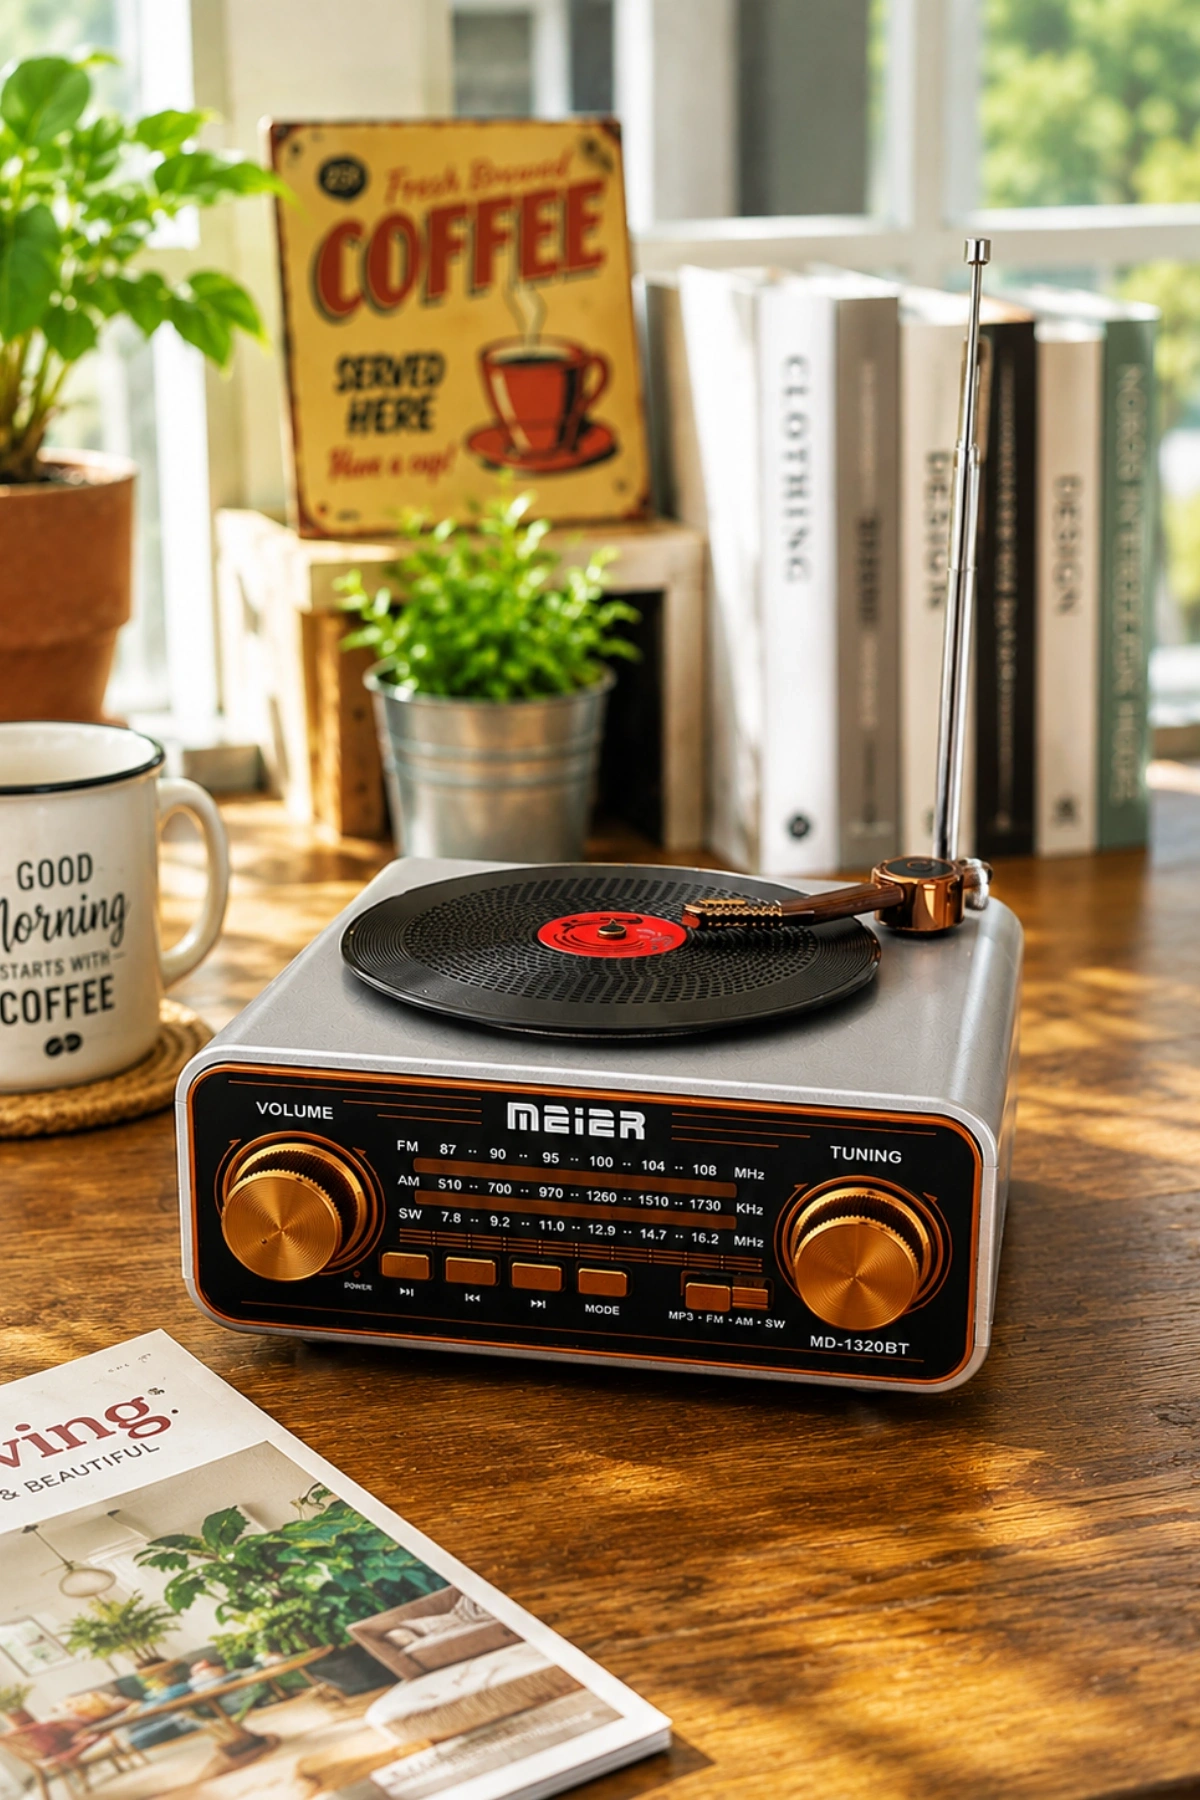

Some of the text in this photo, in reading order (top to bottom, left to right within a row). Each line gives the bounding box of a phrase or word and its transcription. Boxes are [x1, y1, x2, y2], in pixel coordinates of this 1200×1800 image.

[311, 178, 606, 324] COFFEE
[334, 350, 447, 394] SERVED
[346, 396, 436, 437] HERE
[783, 353, 811, 584] CLOTHING
[1052, 474, 1084, 616] DESIGN
[16, 852, 94, 892] GOOD
[0, 951, 111, 981] STARTS WITH
[0, 974, 116, 1026] COFFEE
[255, 1100, 334, 1120] VOLUME
[396, 1139, 765, 1181] FM 87 90 95 100 104 108 MHz
[829, 1145, 902, 1164] TUNING
[397, 1174, 420, 1187] AM
[487, 1181, 513, 1195] 700
[538, 1186, 564, 1199] 970
[586, 1190, 617, 1203] 1260
[638, 1194, 670, 1208] 1510
[689, 1198, 722, 1212] 1730
[736, 1202, 764, 1216] KHz
[398, 1207, 764, 1248] SW 7.8 9.2 11.0 12.9 14.7 16.2 MHz
[343, 1281, 373, 1291] POWER
[584, 1303, 620, 1316] MODE
[668, 1310, 786, 1329] MP3 FM AM SW
[810, 1334, 910, 1355] MD-1320BT
[23, 1442, 160, 1494] BEAUTIFUL
